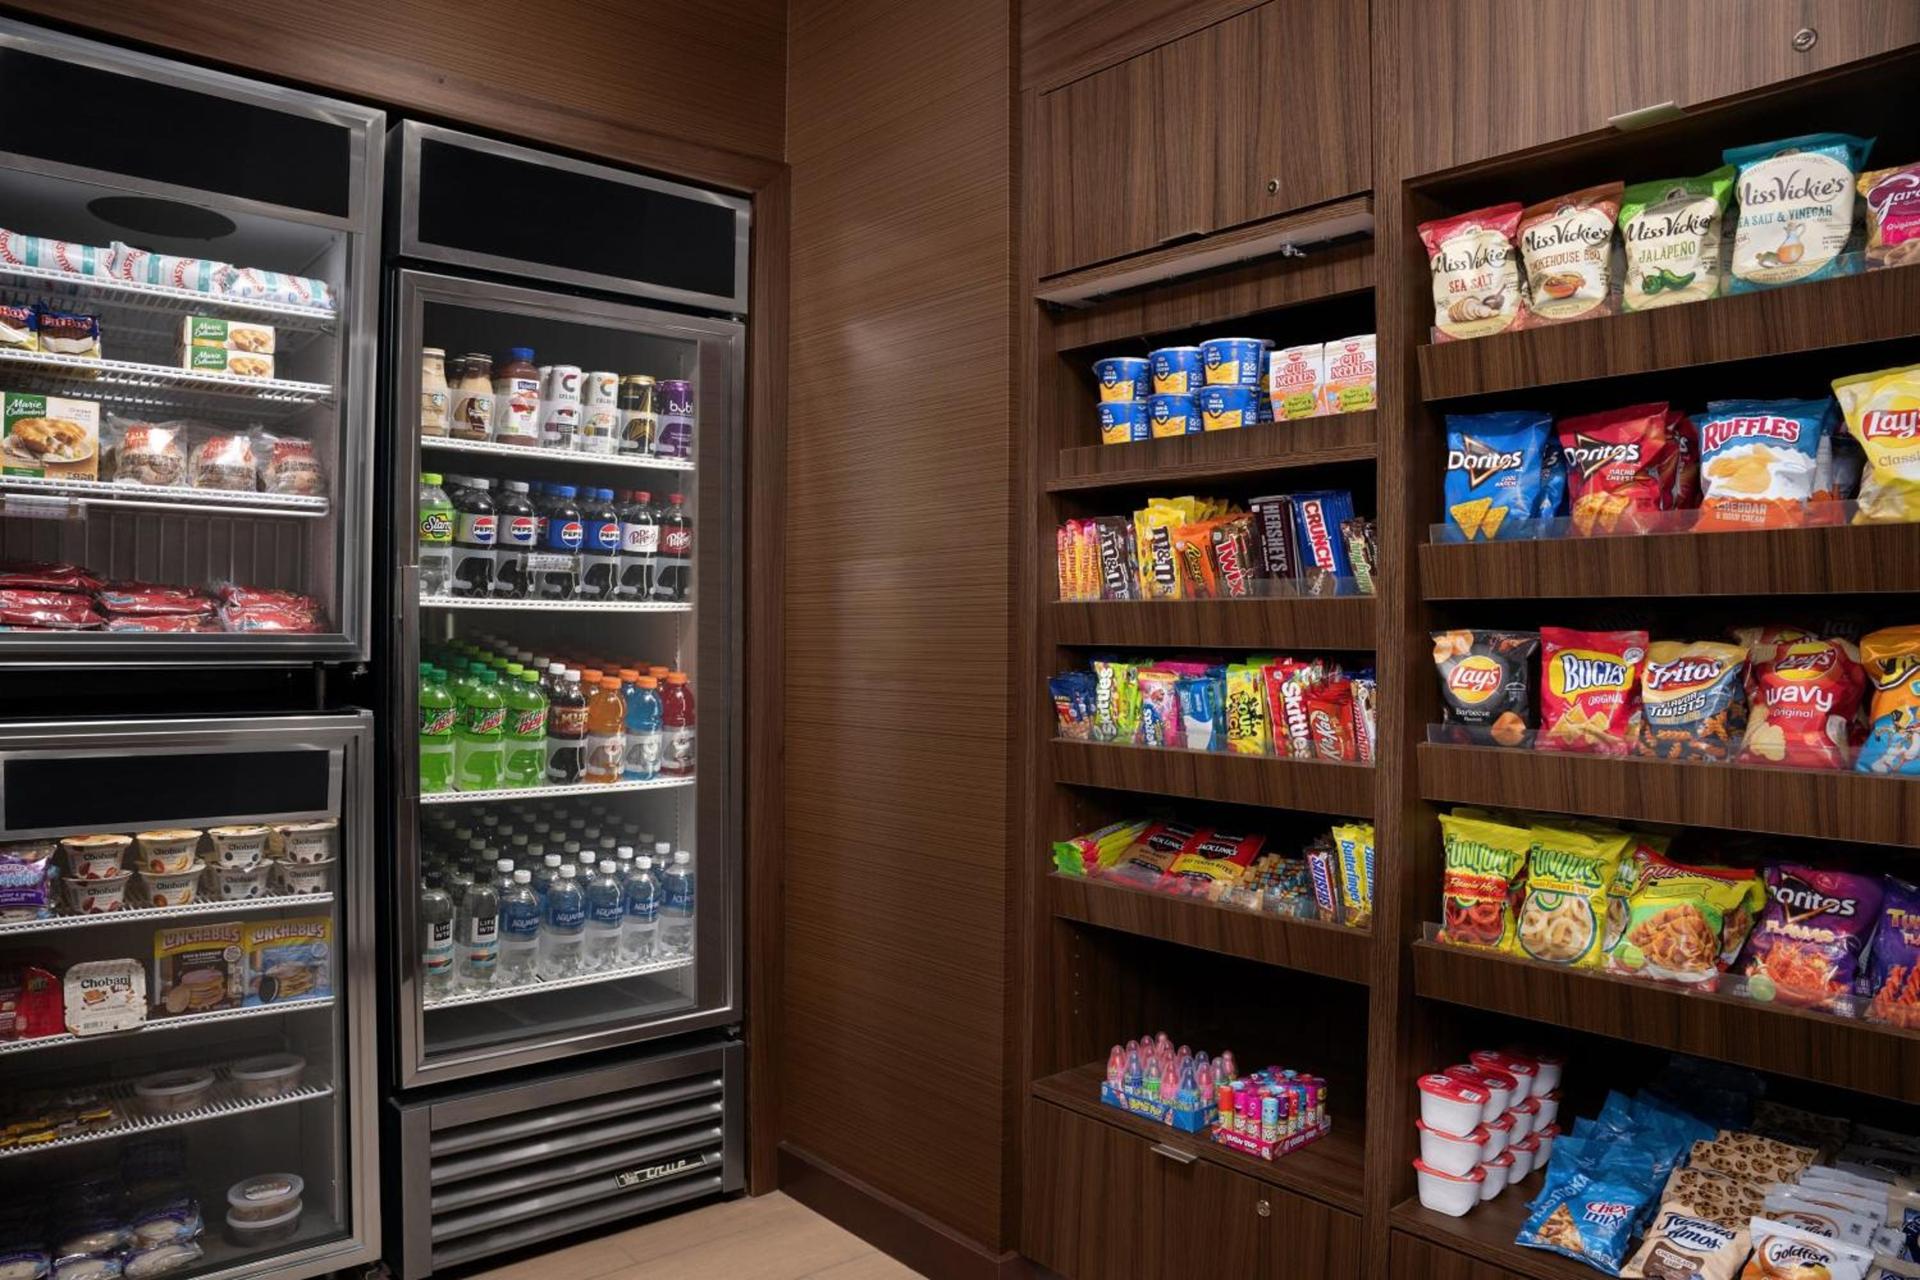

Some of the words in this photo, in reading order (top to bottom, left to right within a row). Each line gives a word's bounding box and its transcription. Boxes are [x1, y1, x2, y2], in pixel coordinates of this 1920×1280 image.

[1773, 169, 1846, 202] Vickie's
[1752, 213, 1774, 227] SALT
[1777, 211, 1786, 222] &
[1789, 204, 1833, 221] VINEGAR
[1553, 218, 1611, 246] Vickie's
[1627, 222, 1665, 243] Miss
[1583, 247, 1602, 262] BBQ
[1638, 240, 1697, 264] JALAPEÑO
[1449, 277, 1467, 294] SEA
[1471, 273, 1494, 290] SALT
[1283, 361, 1308, 376] CUP
[1330, 360, 1375, 380] NOODLES
[1340, 352, 1365, 367] CUP
[1275, 369, 1317, 388] NOODLES
[12, 399, 43, 408] Marie
[669, 400, 693, 413] bub
[1702, 416, 1800, 454] RUFFLES
[1448, 449, 1522, 470] Doritos
[1564, 443, 1640, 466] Doritos
[1716, 501, 1767, 515] CHEDDAR
[1304, 501, 1335, 571] CRUNCH
[1216, 533, 1247, 597] TWIX
[1452, 663, 1500, 690] Lay's
[1561, 653, 1627, 694] BUGLES
[1646, 659, 1724, 689] Fritos
[1587, 692, 1624, 705] ORIGINAL
[1650, 694, 1706, 717] TWISTS
[1766, 686, 1834, 712] wavy
[1229, 692, 1241, 739] PATCH
[1238, 691, 1252, 737] SOUR
[1281, 682, 1311, 758] Skittles
[1197, 843, 1216, 851] JACK
[1342, 840, 1361, 904] Butterfinger
[1530, 842, 1608, 887] FUNYUNS
[163, 928, 241, 949] LUNCHABLES
[253, 922, 325, 943] LUNCHABLES
[81, 974, 132, 989] Chobani
[1530, 1173, 1591, 1223] TRADITIONA
[1585, 1201, 1635, 1215] Chex
[1584, 1213, 1626, 1228] mix
[1668, 1225, 1721, 1249] Amos
[1768, 1242, 1831, 1264] Goldfish
